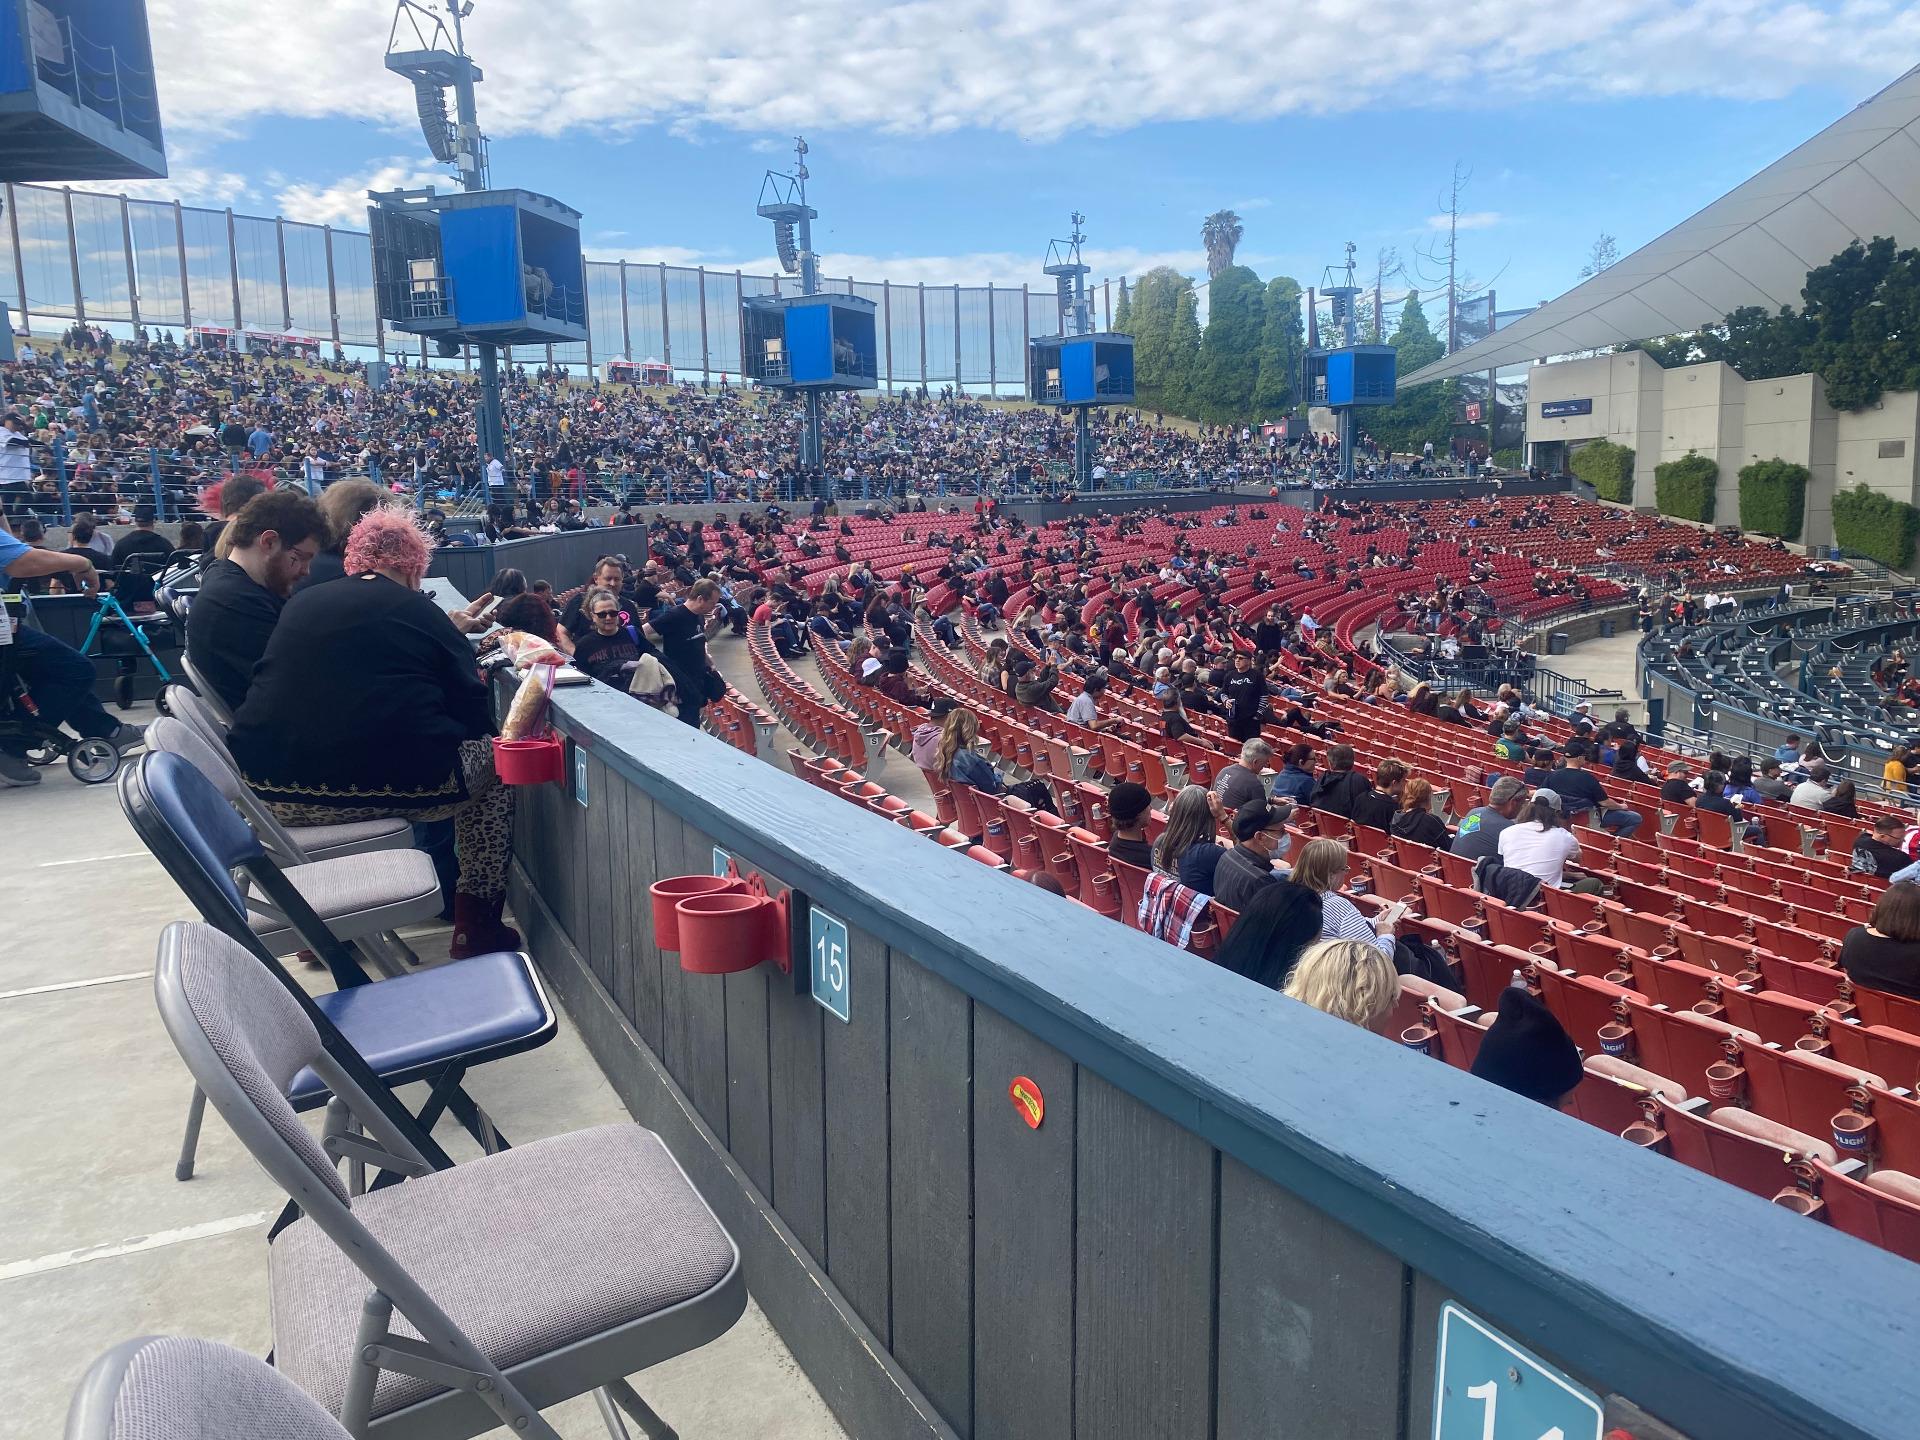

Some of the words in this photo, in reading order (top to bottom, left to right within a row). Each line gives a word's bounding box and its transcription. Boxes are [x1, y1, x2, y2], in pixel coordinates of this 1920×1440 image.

[577, 761, 585, 790] 17
[817, 935, 843, 992] 15
[1603, 1042, 1625, 1052] LIGHT
[1839, 1135, 1866, 1146] LIGHT
[1467, 1380, 1565, 1440] 1
